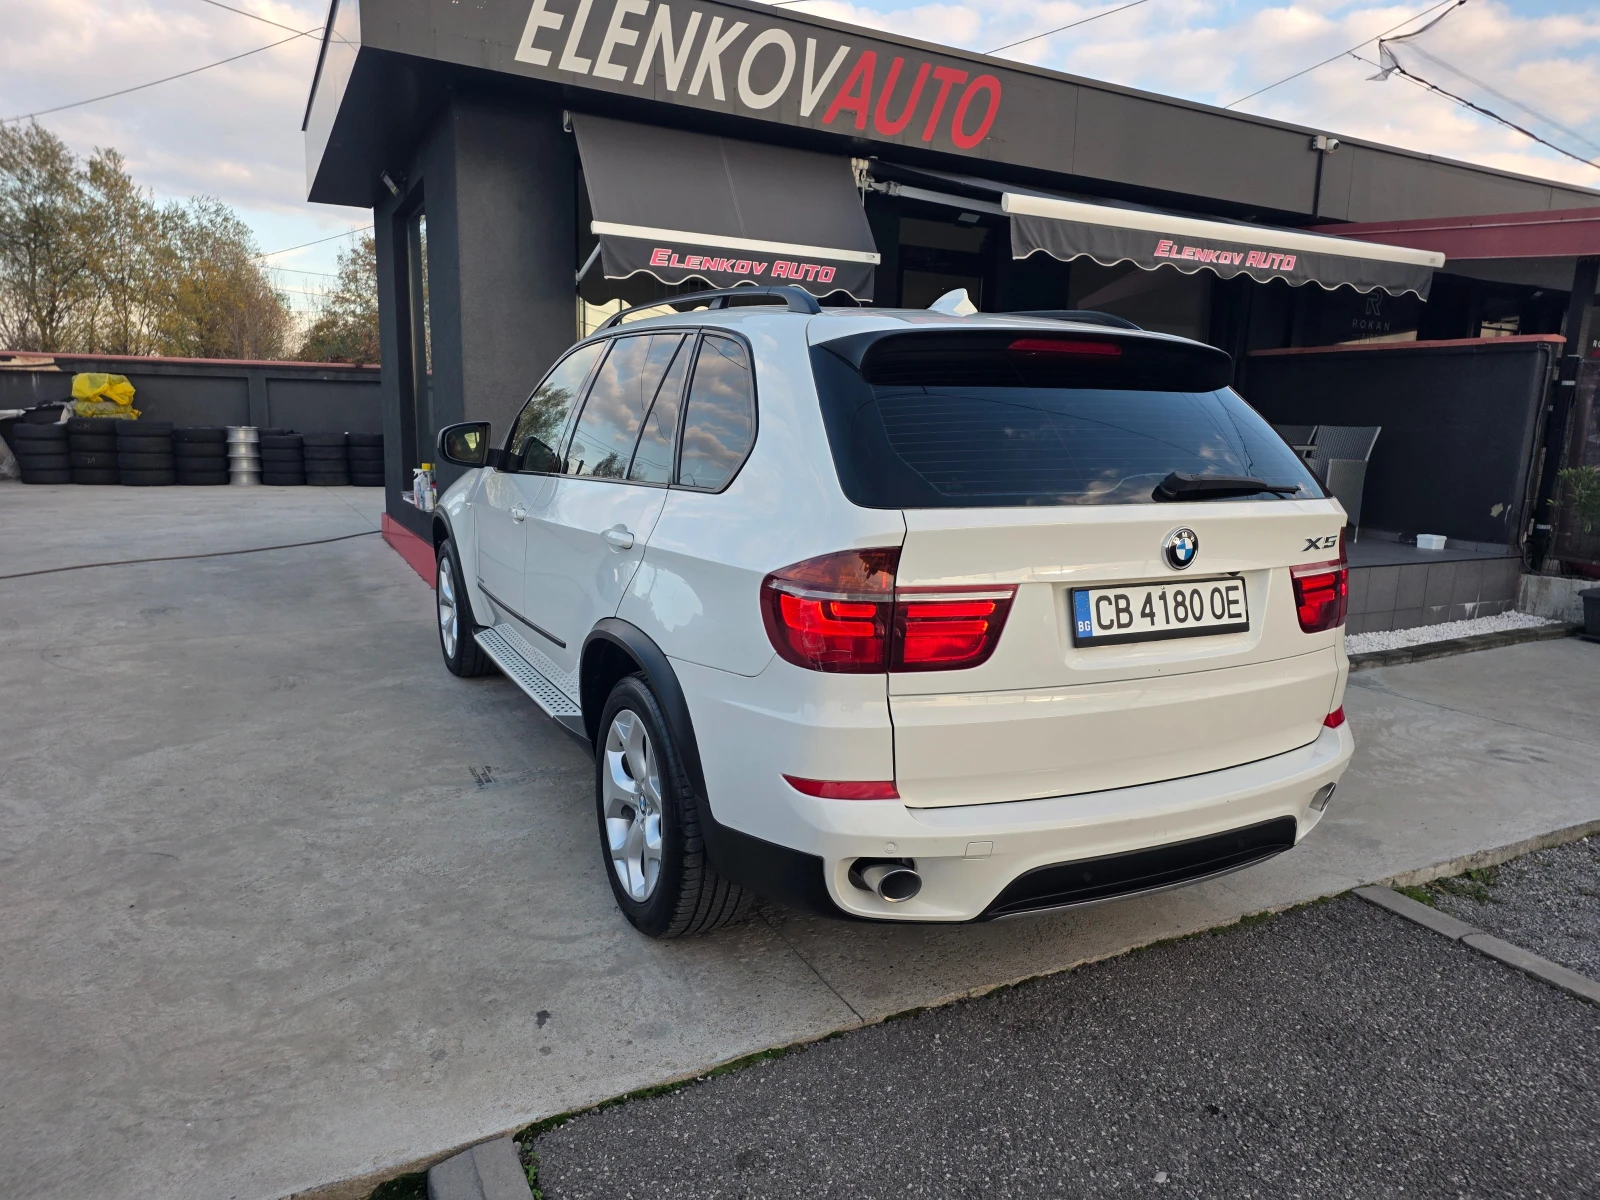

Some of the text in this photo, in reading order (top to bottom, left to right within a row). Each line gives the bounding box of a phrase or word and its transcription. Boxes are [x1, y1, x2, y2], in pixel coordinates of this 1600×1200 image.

[650, 248, 837, 283] ELENKOV AUTO
[1154, 240, 1297, 271] ELENKOV AUTO
[1352, 318, 1391, 331] ROKAN
[1301, 535, 1338, 552] X5
[1095, 585, 1243, 631] CB 4180 OE
[1078, 620, 1091, 632] BG
